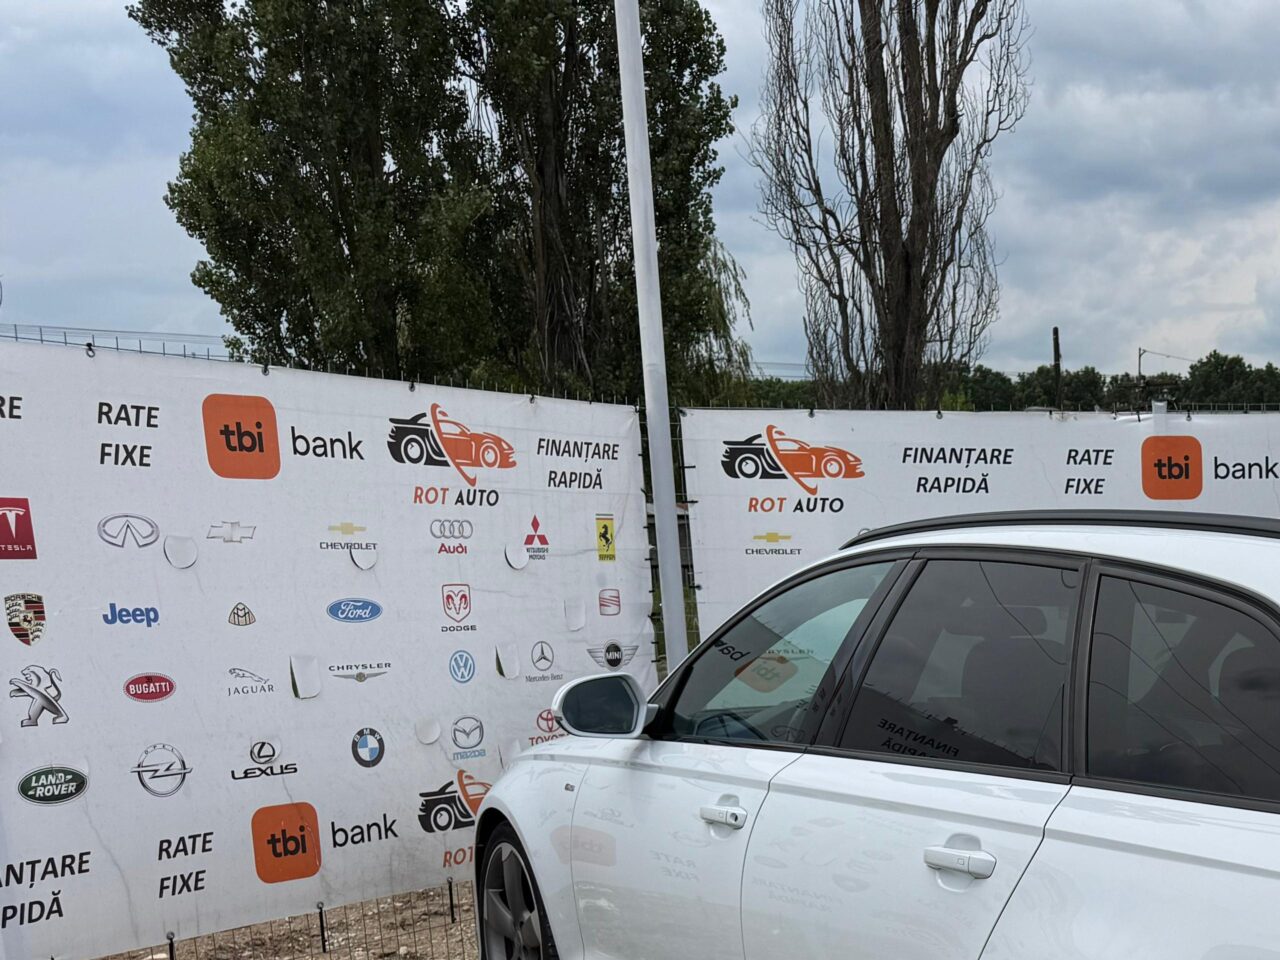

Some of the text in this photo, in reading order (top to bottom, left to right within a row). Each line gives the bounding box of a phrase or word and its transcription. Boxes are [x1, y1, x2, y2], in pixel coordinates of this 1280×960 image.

[97, 402, 160, 428] RATE
[220, 421, 365, 460] tbi bank
[100, 443, 152, 467] FIXE
[537, 438, 619, 463] FINANȚARE
[902, 447, 1014, 469] FINANȚARE
[1066, 449, 1114, 466] RATE
[1154, 455, 1279, 480] tbi bank
[548, 468, 603, 490] RAPIDĂ
[916, 473, 989, 494] RAPIDĂ
[1064, 478, 1105, 495] FIXE
[413, 486, 499, 506] ROT AUTO
[749, 497, 844, 513] ROT AUTO
[320, 542, 378, 551] CHEVROLET
[438, 543, 467, 554] Audi
[102, 603, 160, 627] Jeep
[337, 600, 372, 619] Ford
[606, 651, 622, 660] MINI
[328, 662, 391, 671] CHRYSLER
[129, 681, 170, 695] BUGATTI
[228, 684, 274, 697] JAGUAR
[453, 749, 487, 760] mazda
[231, 763, 298, 780] LEXUS
[35, 782, 77, 797] ROVER
[267, 813, 399, 858] tbi bank
[158, 832, 214, 860] RATE
[158, 870, 206, 898] FIXE
